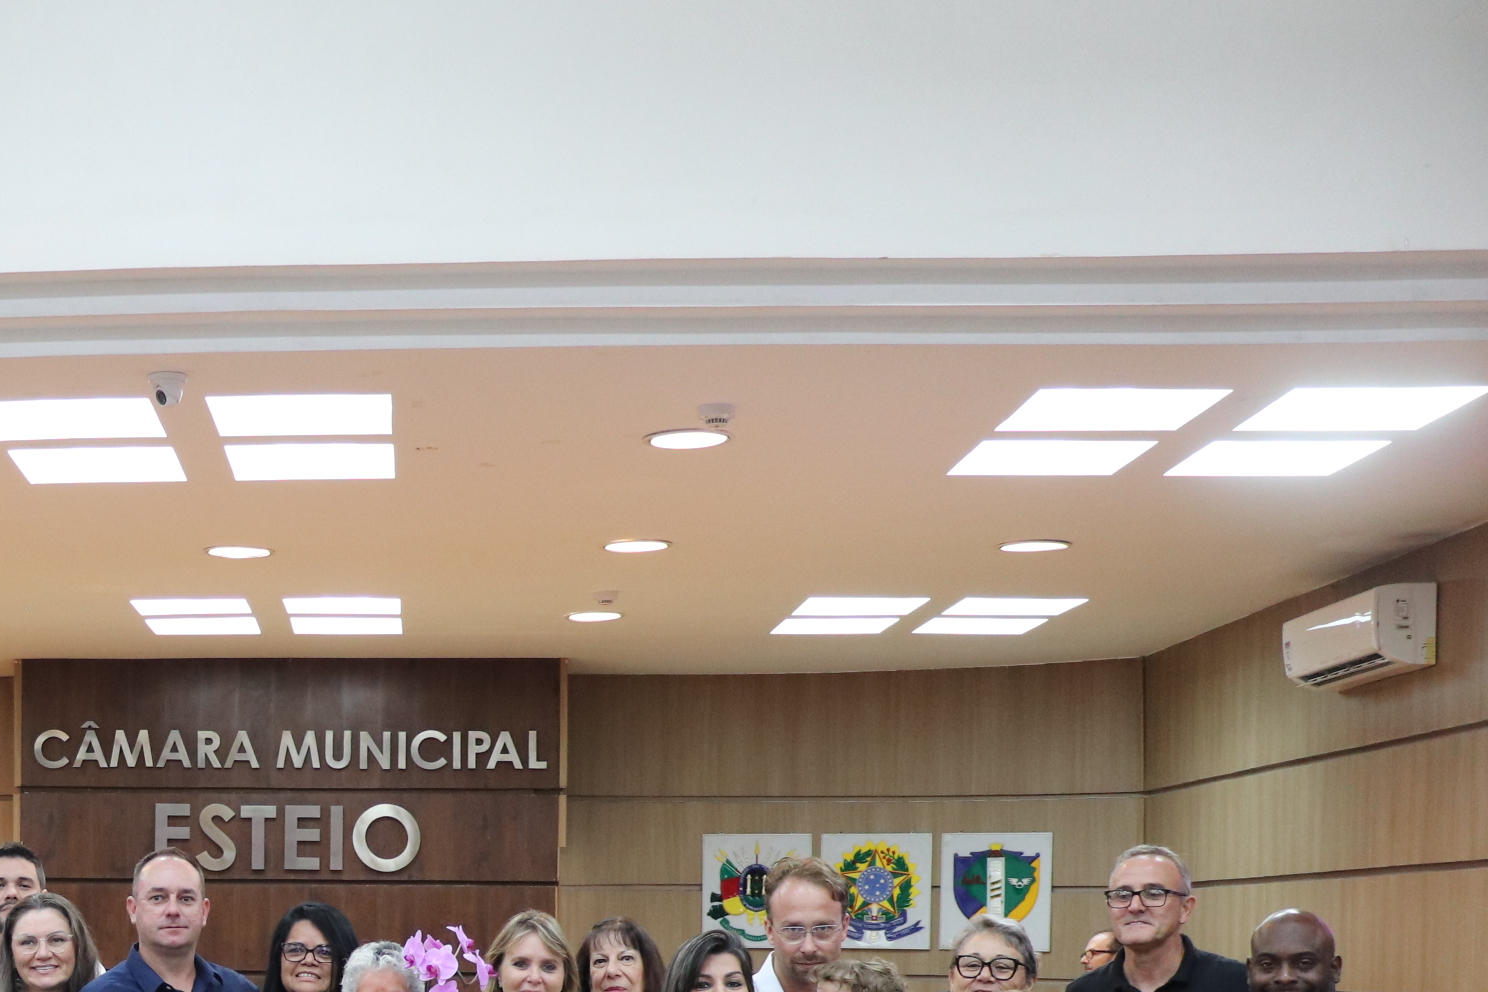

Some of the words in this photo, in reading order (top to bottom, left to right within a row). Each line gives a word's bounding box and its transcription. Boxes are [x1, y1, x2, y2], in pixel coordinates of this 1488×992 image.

[33, 720, 260, 769] CÂMARA
[276, 729, 548, 771] MUNICIPAL
[154, 802, 421, 873] ESTEIO
